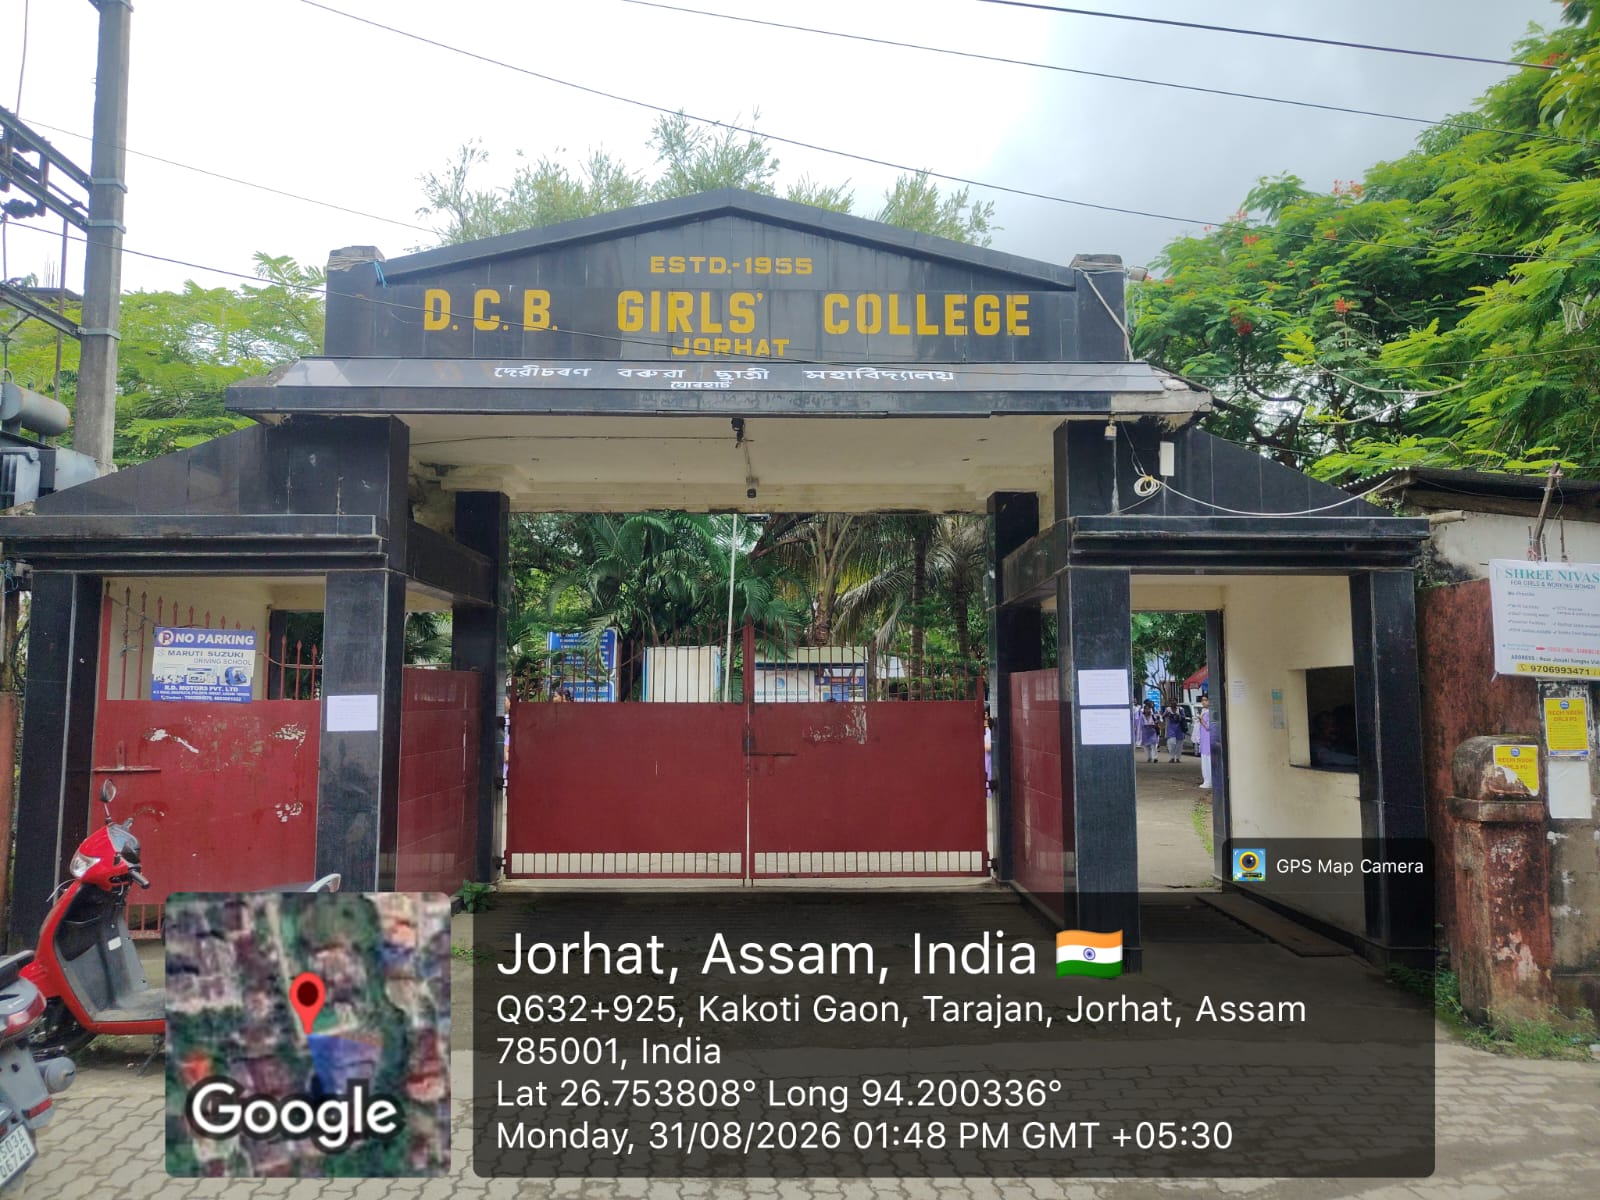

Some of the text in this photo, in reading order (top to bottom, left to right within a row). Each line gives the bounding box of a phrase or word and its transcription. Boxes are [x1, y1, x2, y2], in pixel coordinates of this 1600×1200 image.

[650, 256, 814, 275] ESTD.-1955
[424, 289, 458, 332] D.
[473, 289, 509, 332] C.
[524, 289, 559, 332] B.
[824, 293, 1031, 337] COLLEGE
[672, 338, 790, 357] JORHAT
[1505, 568, 1553, 580] SHREE
[175, 633, 255, 646] NO PARKING
[167, 650, 244, 659] MARUTI SUZUKI
